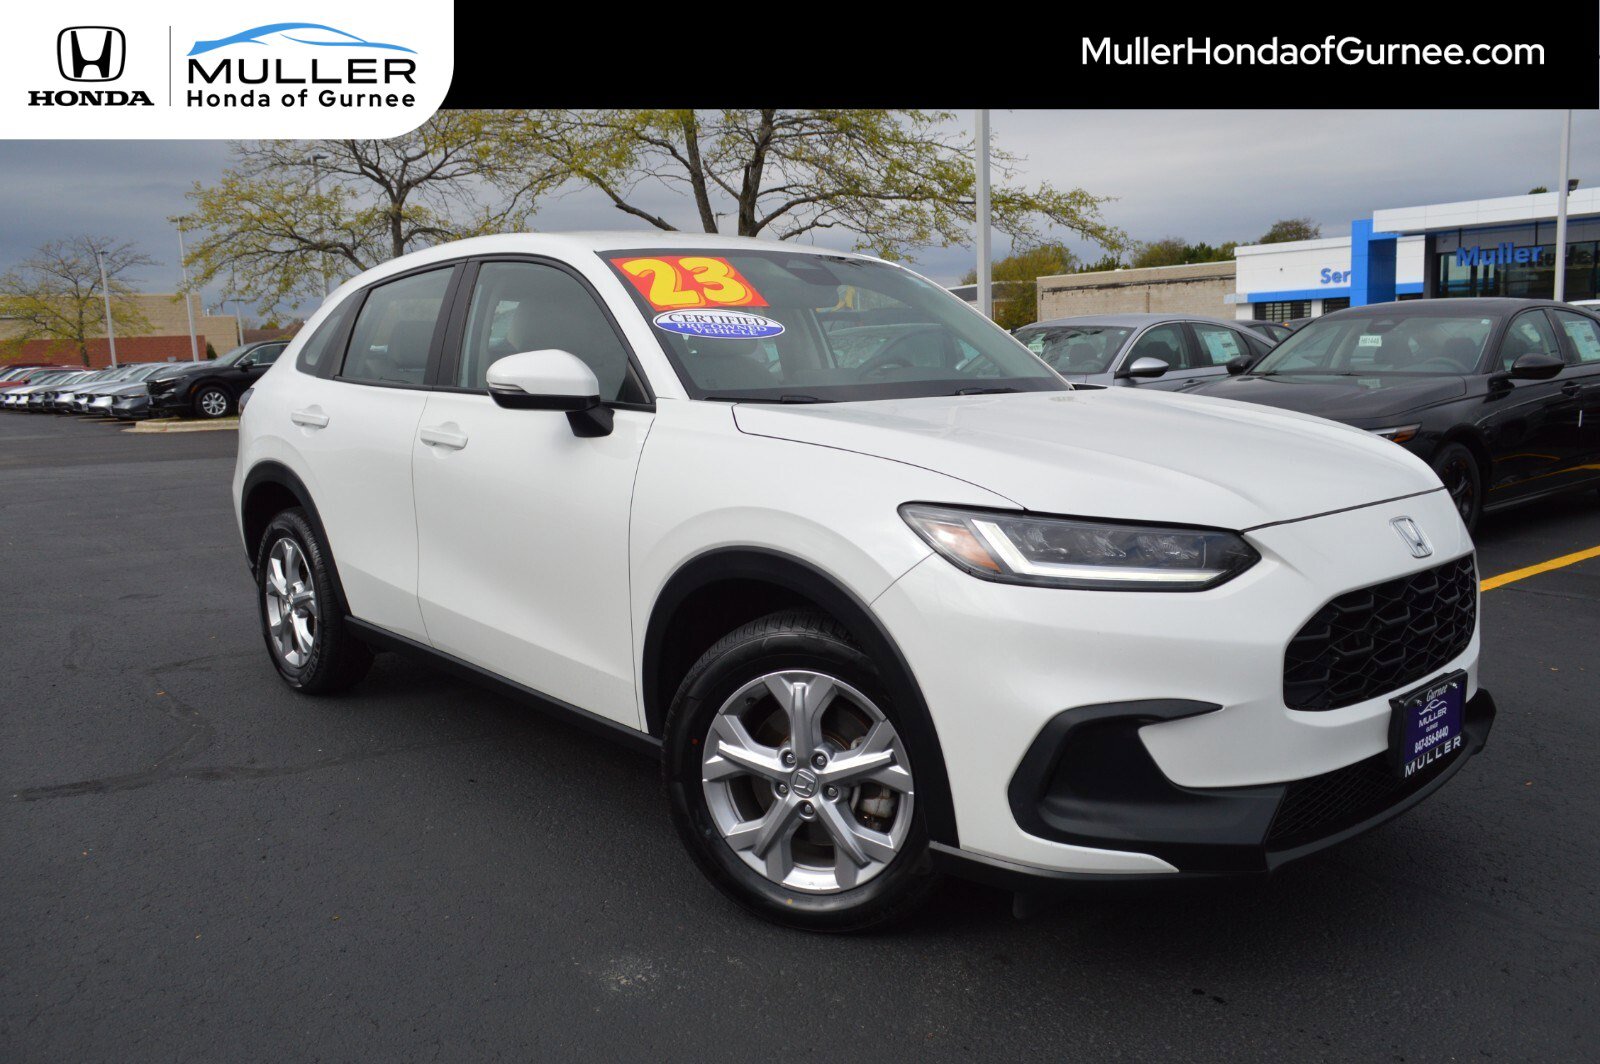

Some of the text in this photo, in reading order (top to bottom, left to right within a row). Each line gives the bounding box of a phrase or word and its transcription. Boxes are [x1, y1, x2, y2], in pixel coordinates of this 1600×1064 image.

[1456, 242, 1544, 267] Muller
[621, 256, 753, 307] 23
[669, 314, 768, 326] CERTIFIED
[677, 323, 768, 331] PRE-OWNED
[694, 328, 758, 336] VEHICLE
[1419, 707, 1447, 727] MULLER
[1405, 736, 1460, 777] MULLER
